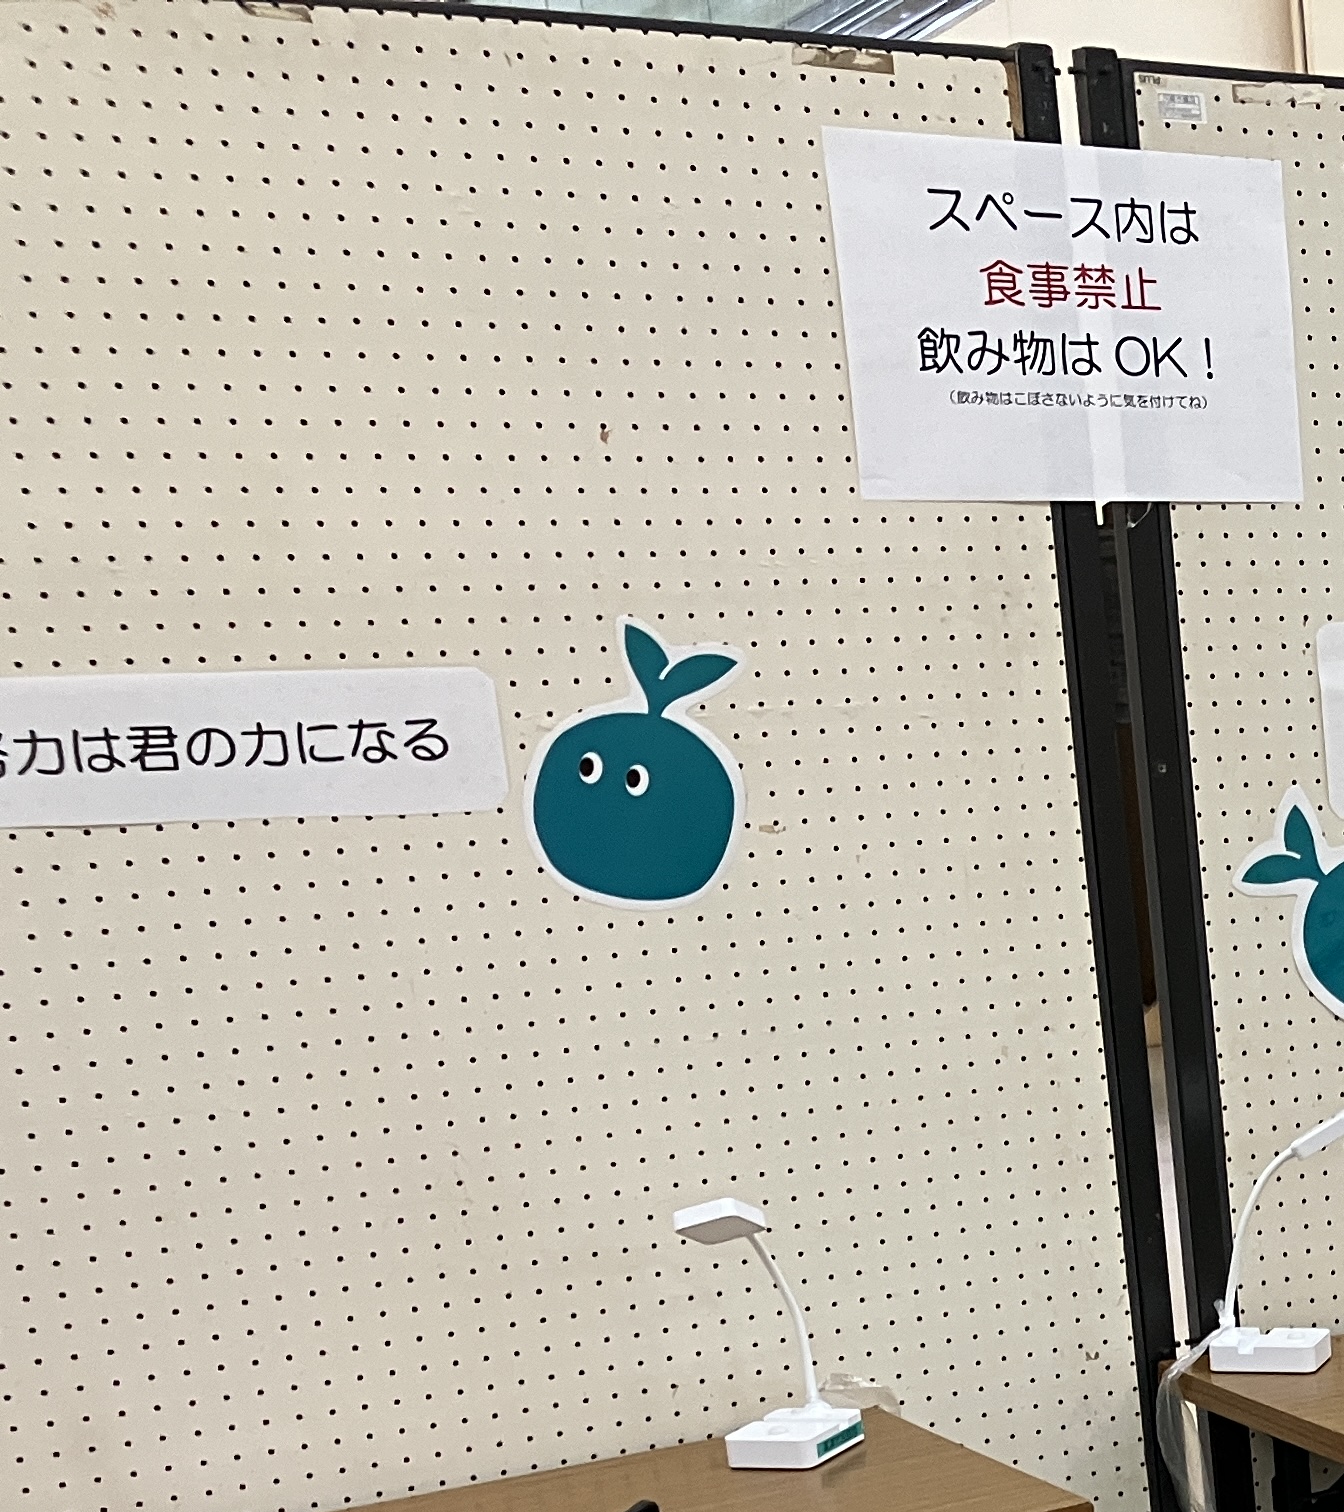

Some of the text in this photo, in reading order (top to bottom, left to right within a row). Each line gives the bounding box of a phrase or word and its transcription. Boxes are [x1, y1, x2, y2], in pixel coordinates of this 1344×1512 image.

[926, 187, 1200, 245] スペース内は
[979, 259, 1162, 311] 食事禁止
[917, 326, 1102, 377] 飲み物は
[0, 717, 450, 778] 力は君の力になる
